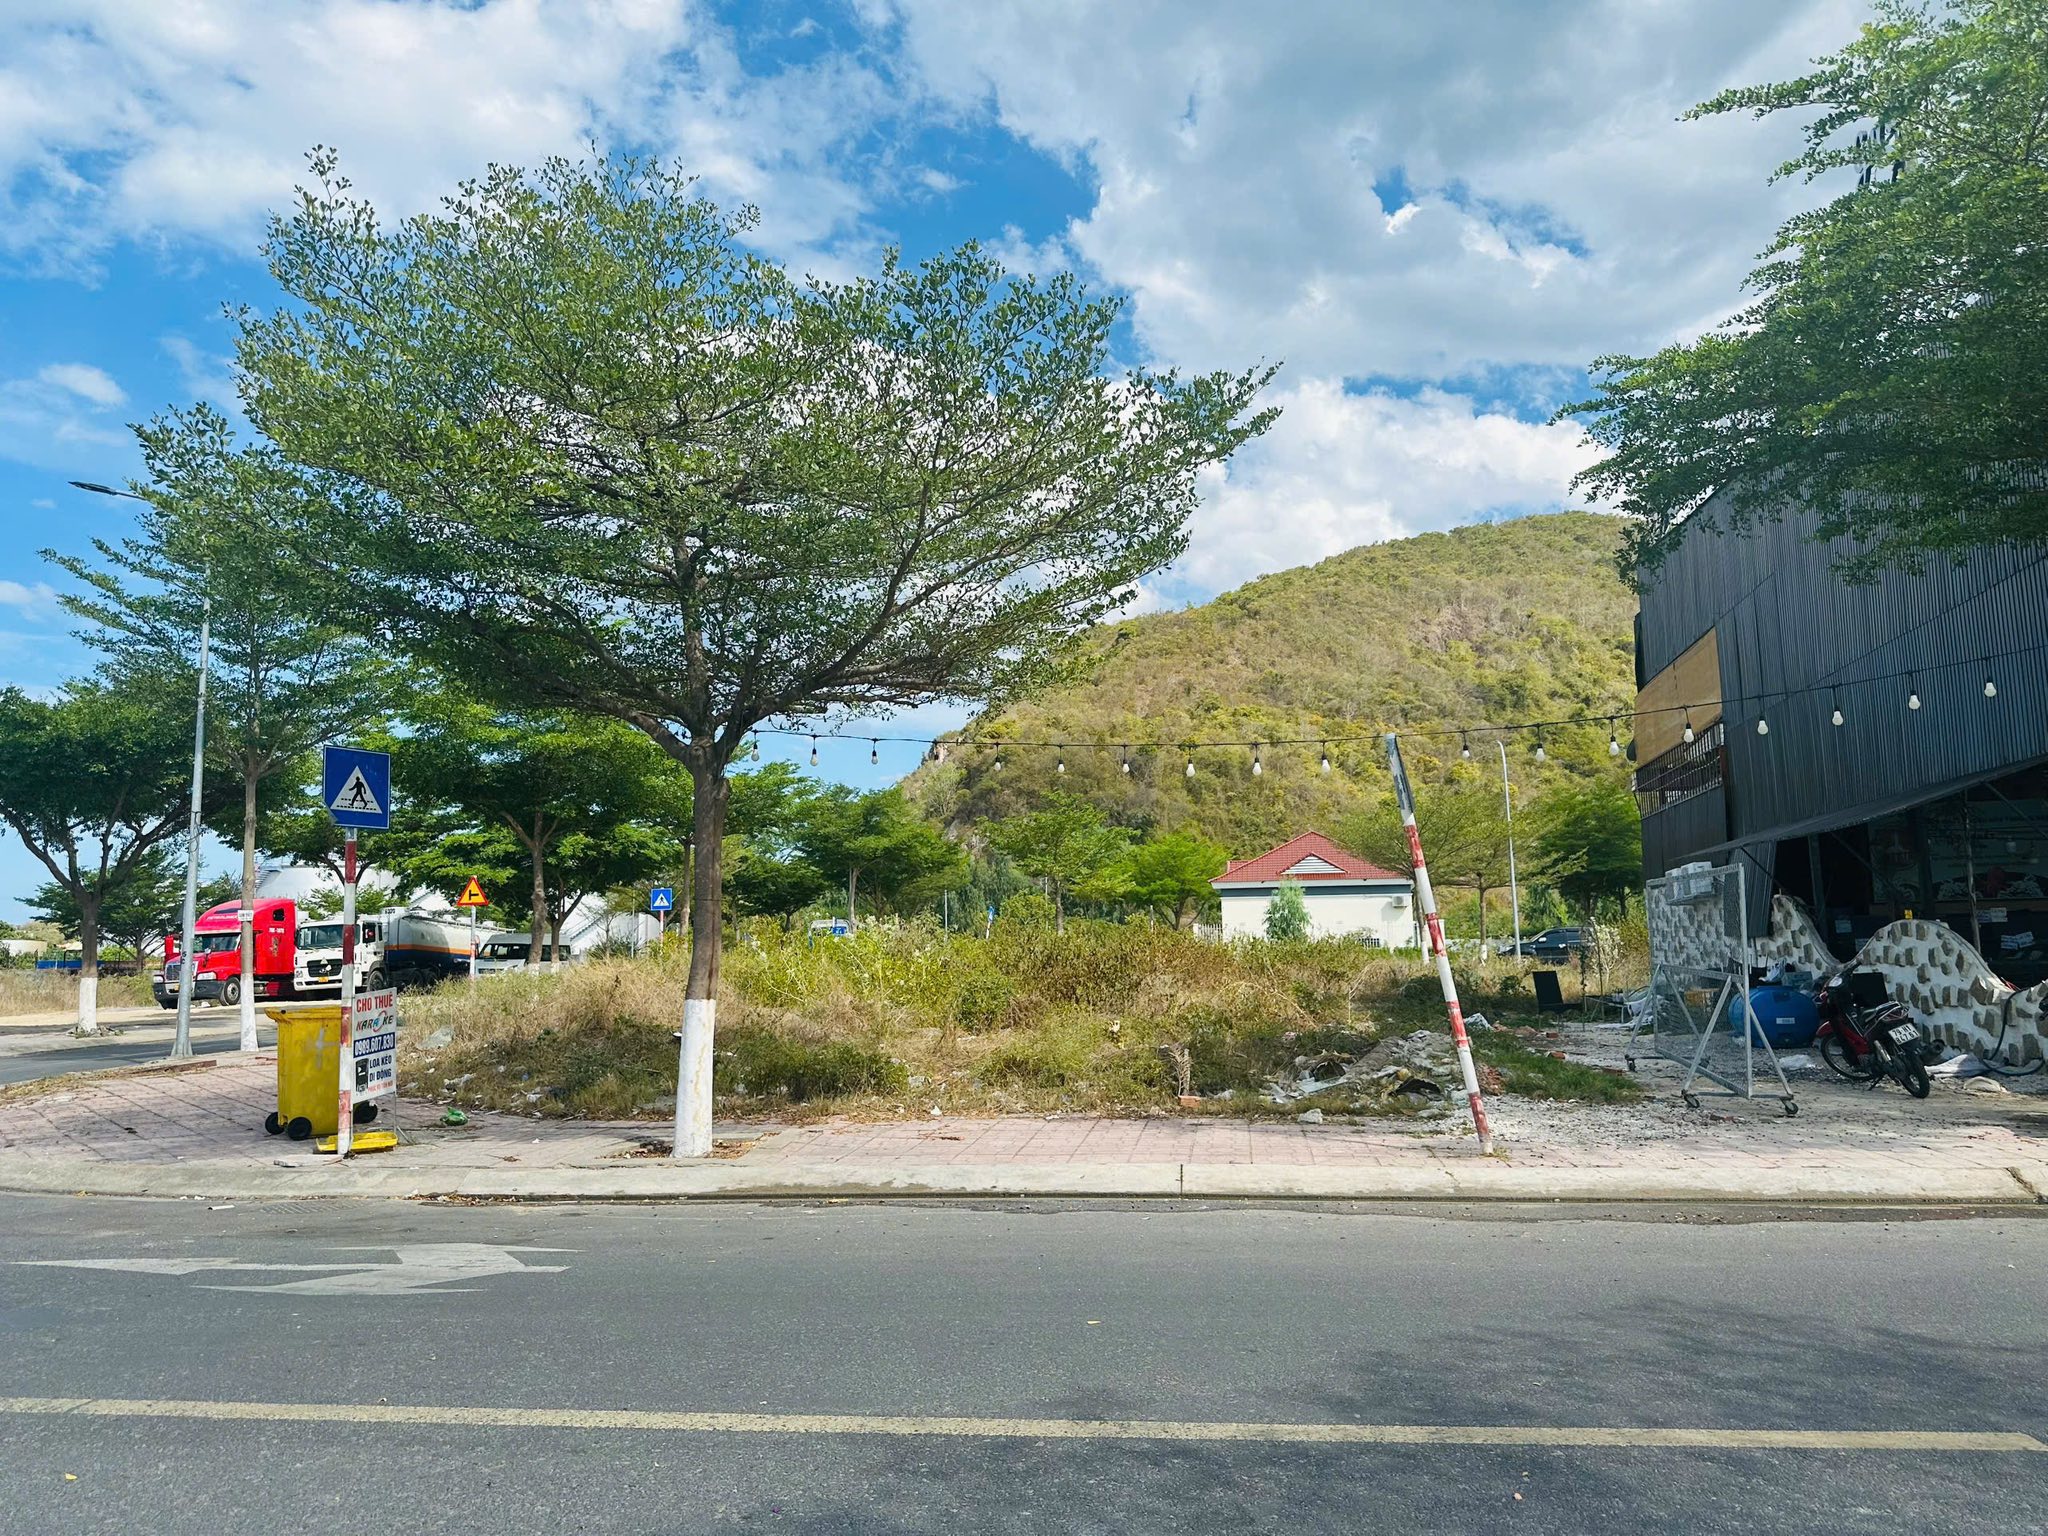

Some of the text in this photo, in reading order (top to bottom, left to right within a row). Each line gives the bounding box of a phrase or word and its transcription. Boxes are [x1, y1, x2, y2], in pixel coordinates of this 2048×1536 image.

[356, 992, 393, 1013] CHO THUÊ
[370, 1058, 380, 1068] LOA
